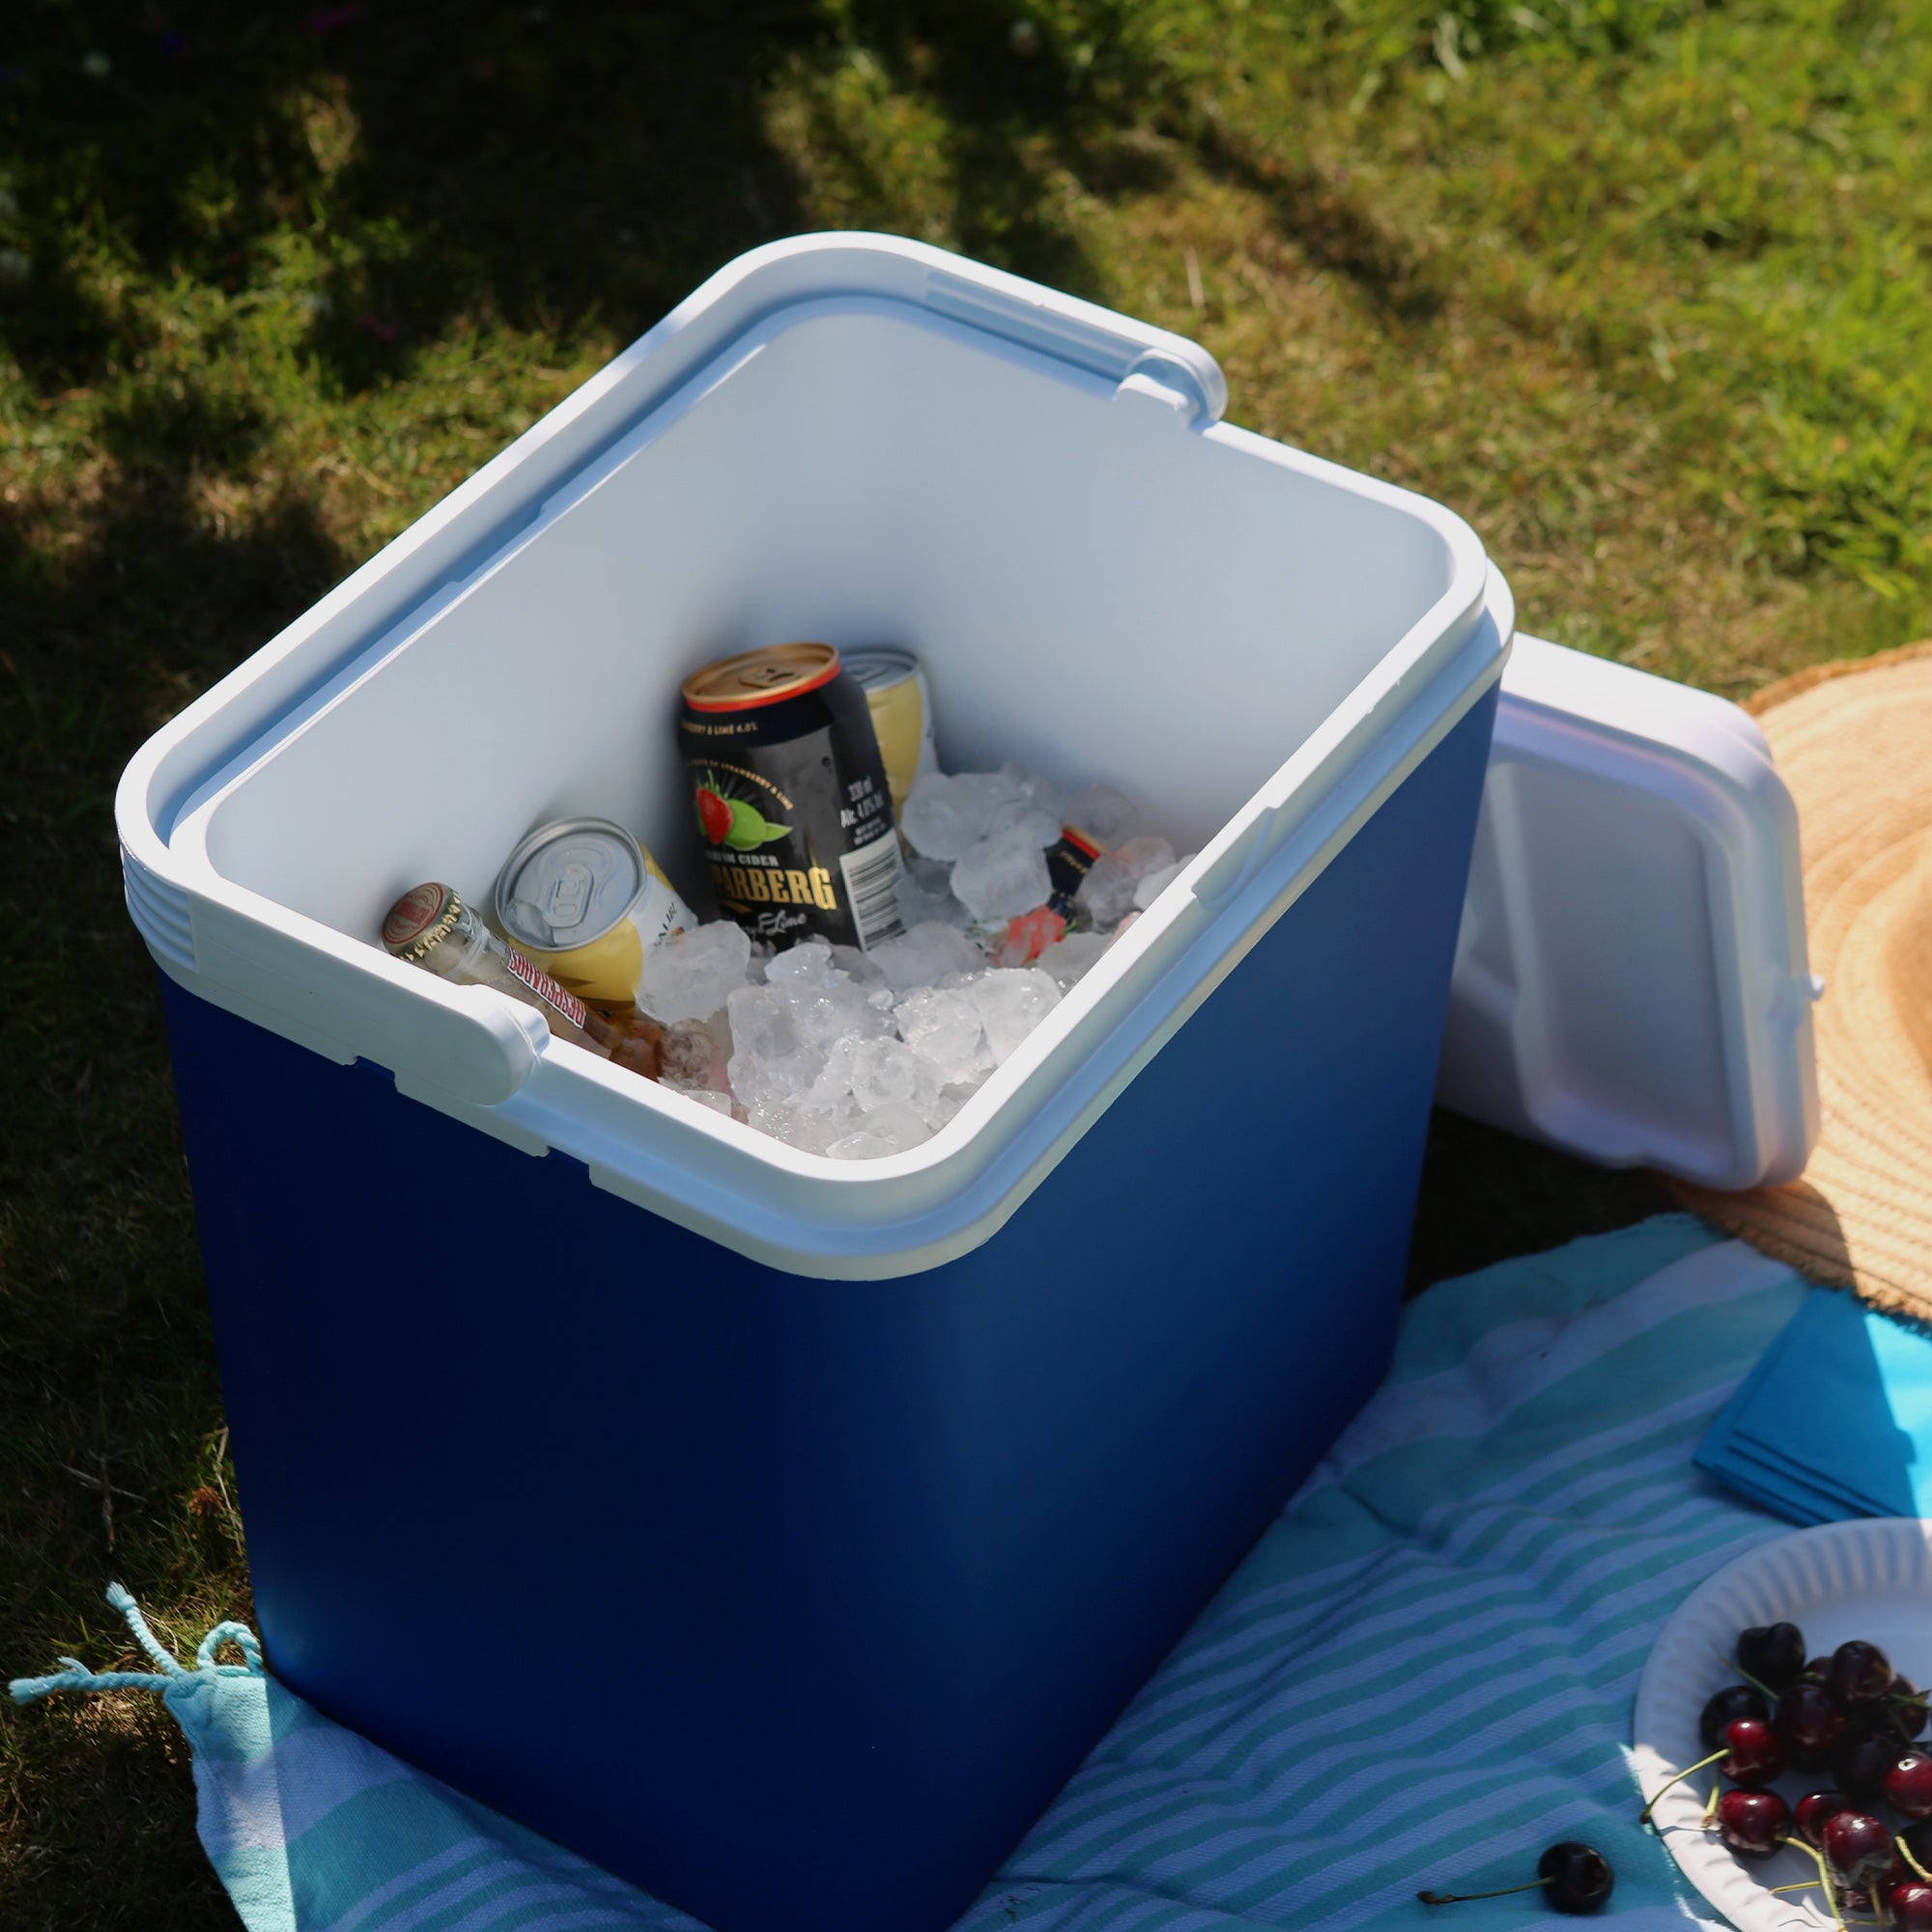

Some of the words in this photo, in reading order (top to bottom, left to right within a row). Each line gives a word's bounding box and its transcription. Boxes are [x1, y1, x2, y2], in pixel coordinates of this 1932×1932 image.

[715, 724, 734, 735] LIME
[738, 854, 779, 867] CIDER
[507, 945, 586, 1030] DESPERADOS
